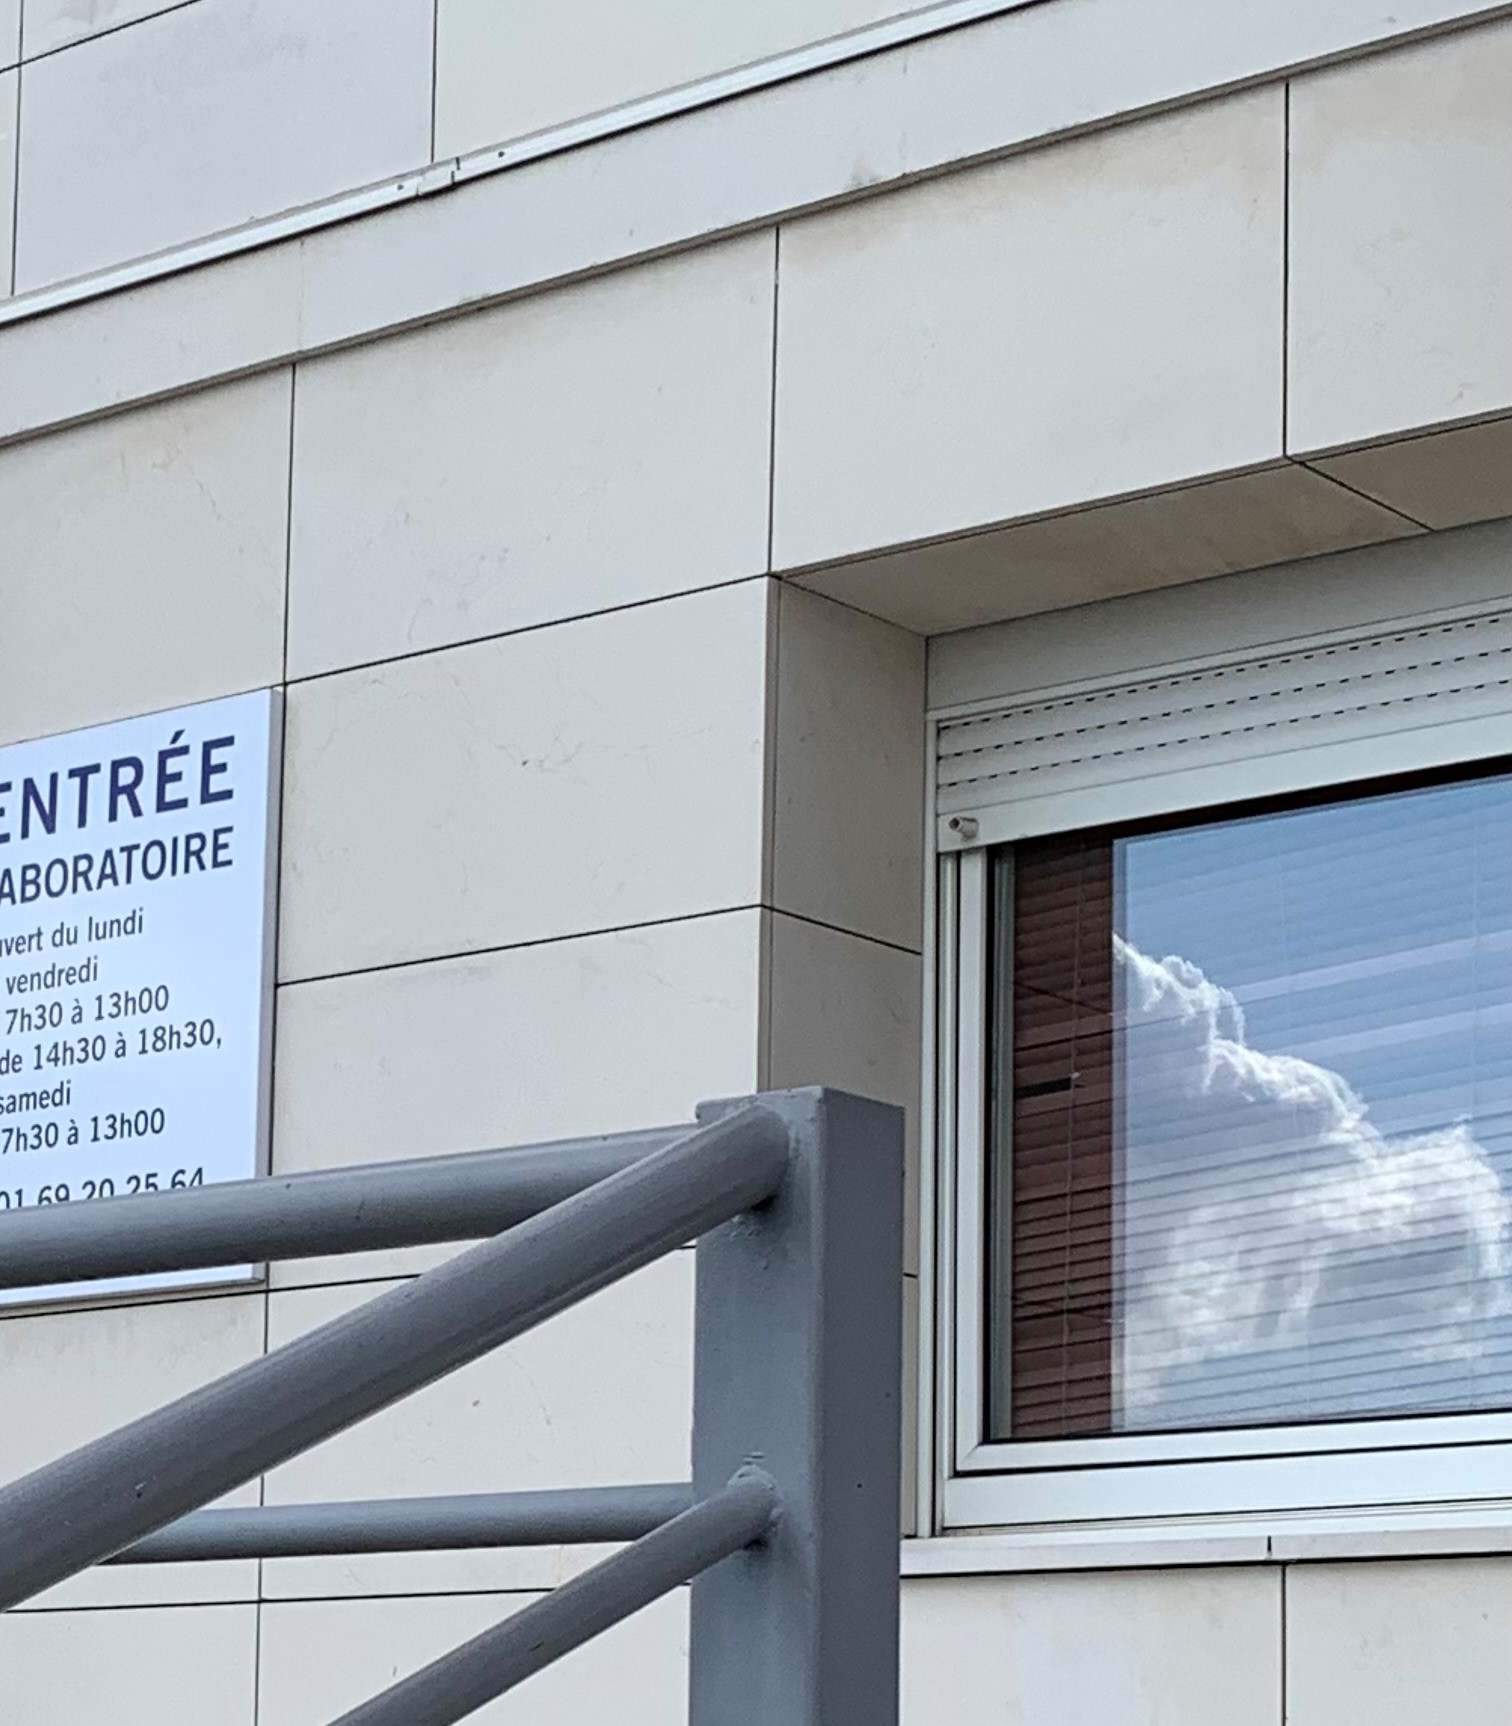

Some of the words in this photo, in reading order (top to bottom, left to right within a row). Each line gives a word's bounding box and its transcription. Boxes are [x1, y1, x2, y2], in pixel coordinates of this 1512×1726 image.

[51, 921, 78, 948] du
[87, 908, 144, 942] lundi
[5, 955, 99, 995] vendredi
[5, 1001, 63, 1035] 7h30
[70, 998, 83, 1025] à
[94, 984, 170, 1021] 13h00
[33, 1034, 107, 1071] 14h30
[114, 1031, 127, 1059] à
[138, 1018, 222, 1055] 18h30,
[1, 1121, 59, 1155] 7h30
[66, 1118, 79, 1146] à
[90, 1107, 166, 1143] 13h00
